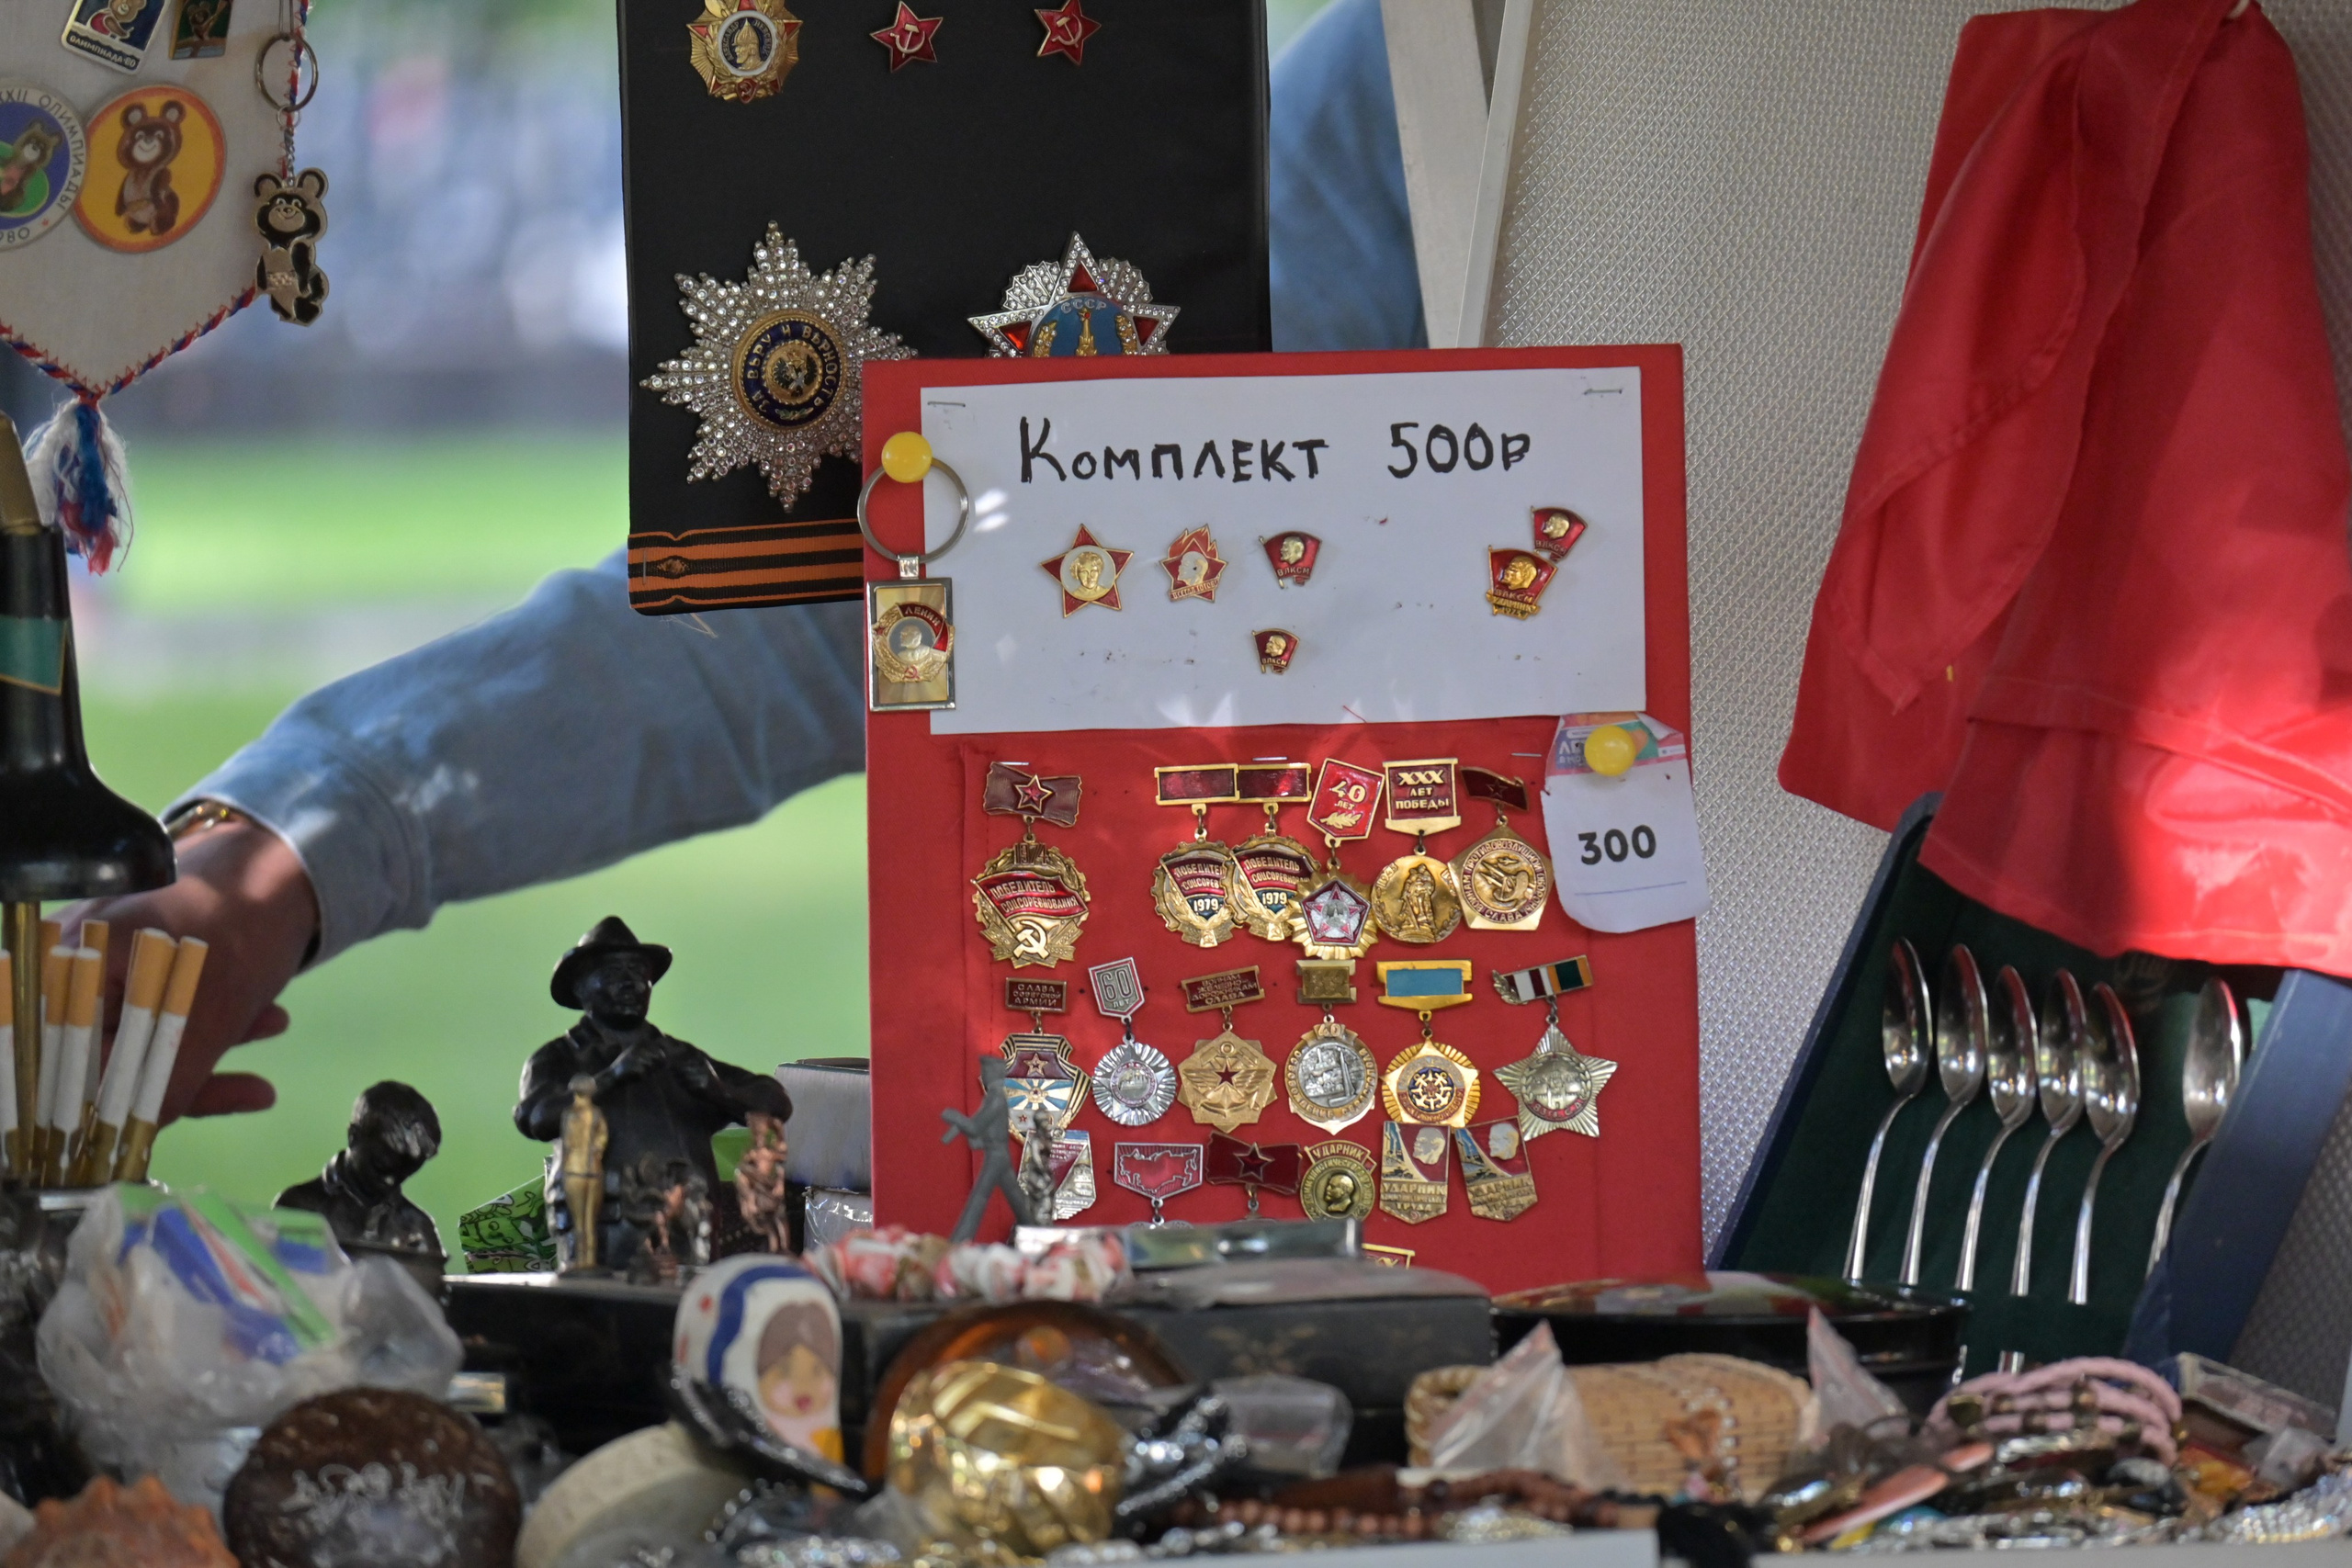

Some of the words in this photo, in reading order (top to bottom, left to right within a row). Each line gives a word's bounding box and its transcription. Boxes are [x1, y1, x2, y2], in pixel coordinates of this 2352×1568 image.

[1060, 299, 1107, 313] СССР
[1277, 566, 1311, 578] ВЛКСМ
[1495, 589, 1534, 604] ВЛКСМ
[905, 607, 941, 627] ЛЕНИН
[1329, 781, 1367, 804] 40
[1410, 786, 1434, 797] ЛЕТ
[1335, 799, 1356, 811] ЛЕТ
[1396, 797, 1451, 810] ПОБЕДЫ
[1577, 824, 1657, 865] 300
[1243, 856, 1301, 872] ПОБЕДИТЕЛЬ
[989, 880, 1057, 900] ПОБЕДИТЕЛЬ
[1463, 874, 1484, 912] ВОИНАМ
[1000, 896, 1080, 914] СОЦСОРЕВНОВАНИЯ
[1193, 898, 1219, 911] 1979
[1261, 892, 1287, 907] 1979
[1484, 909, 1523, 922] СЛАВА
[1017, 984, 1056, 993] СЛАВА
[1100, 968, 1132, 1002] 60
[1014, 997, 1057, 1007] АРМИИ
[1113, 998, 1130, 1009] ЛЕТ
[1204, 991, 1246, 1005] СЛАВА
[1317, 1023, 1341, 1037] 40
[1312, 1144, 1365, 1161] УДАРНИК
[1383, 1182, 1445, 1195] УДАРНИК
